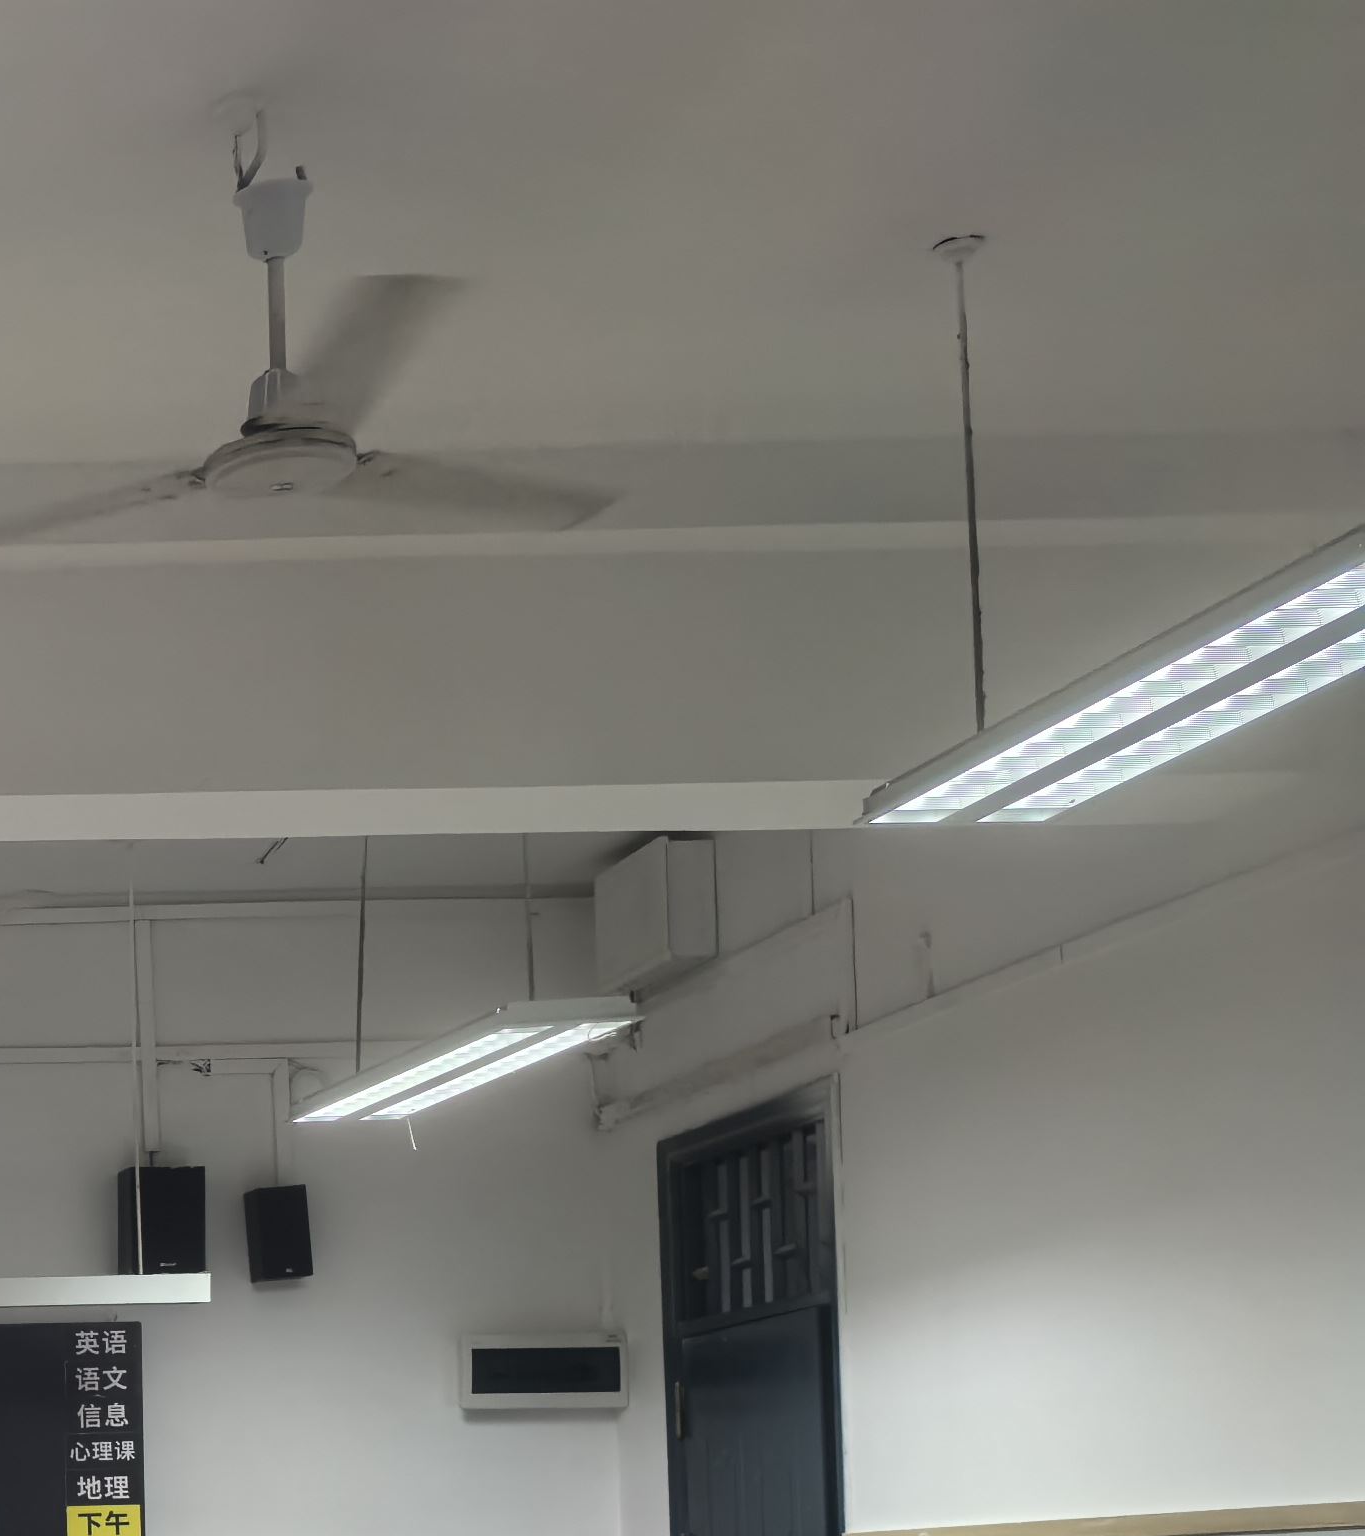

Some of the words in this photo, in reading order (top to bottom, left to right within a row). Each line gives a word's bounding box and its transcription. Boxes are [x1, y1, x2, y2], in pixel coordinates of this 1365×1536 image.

[75, 1330, 127, 1355] 英语
[75, 1366, 128, 1392] 语文
[77, 1402, 129, 1428] 信息
[70, 1440, 136, 1462] 心理课
[76, 1475, 130, 1500] 地理
[77, 1510, 130, 1536] 下午
